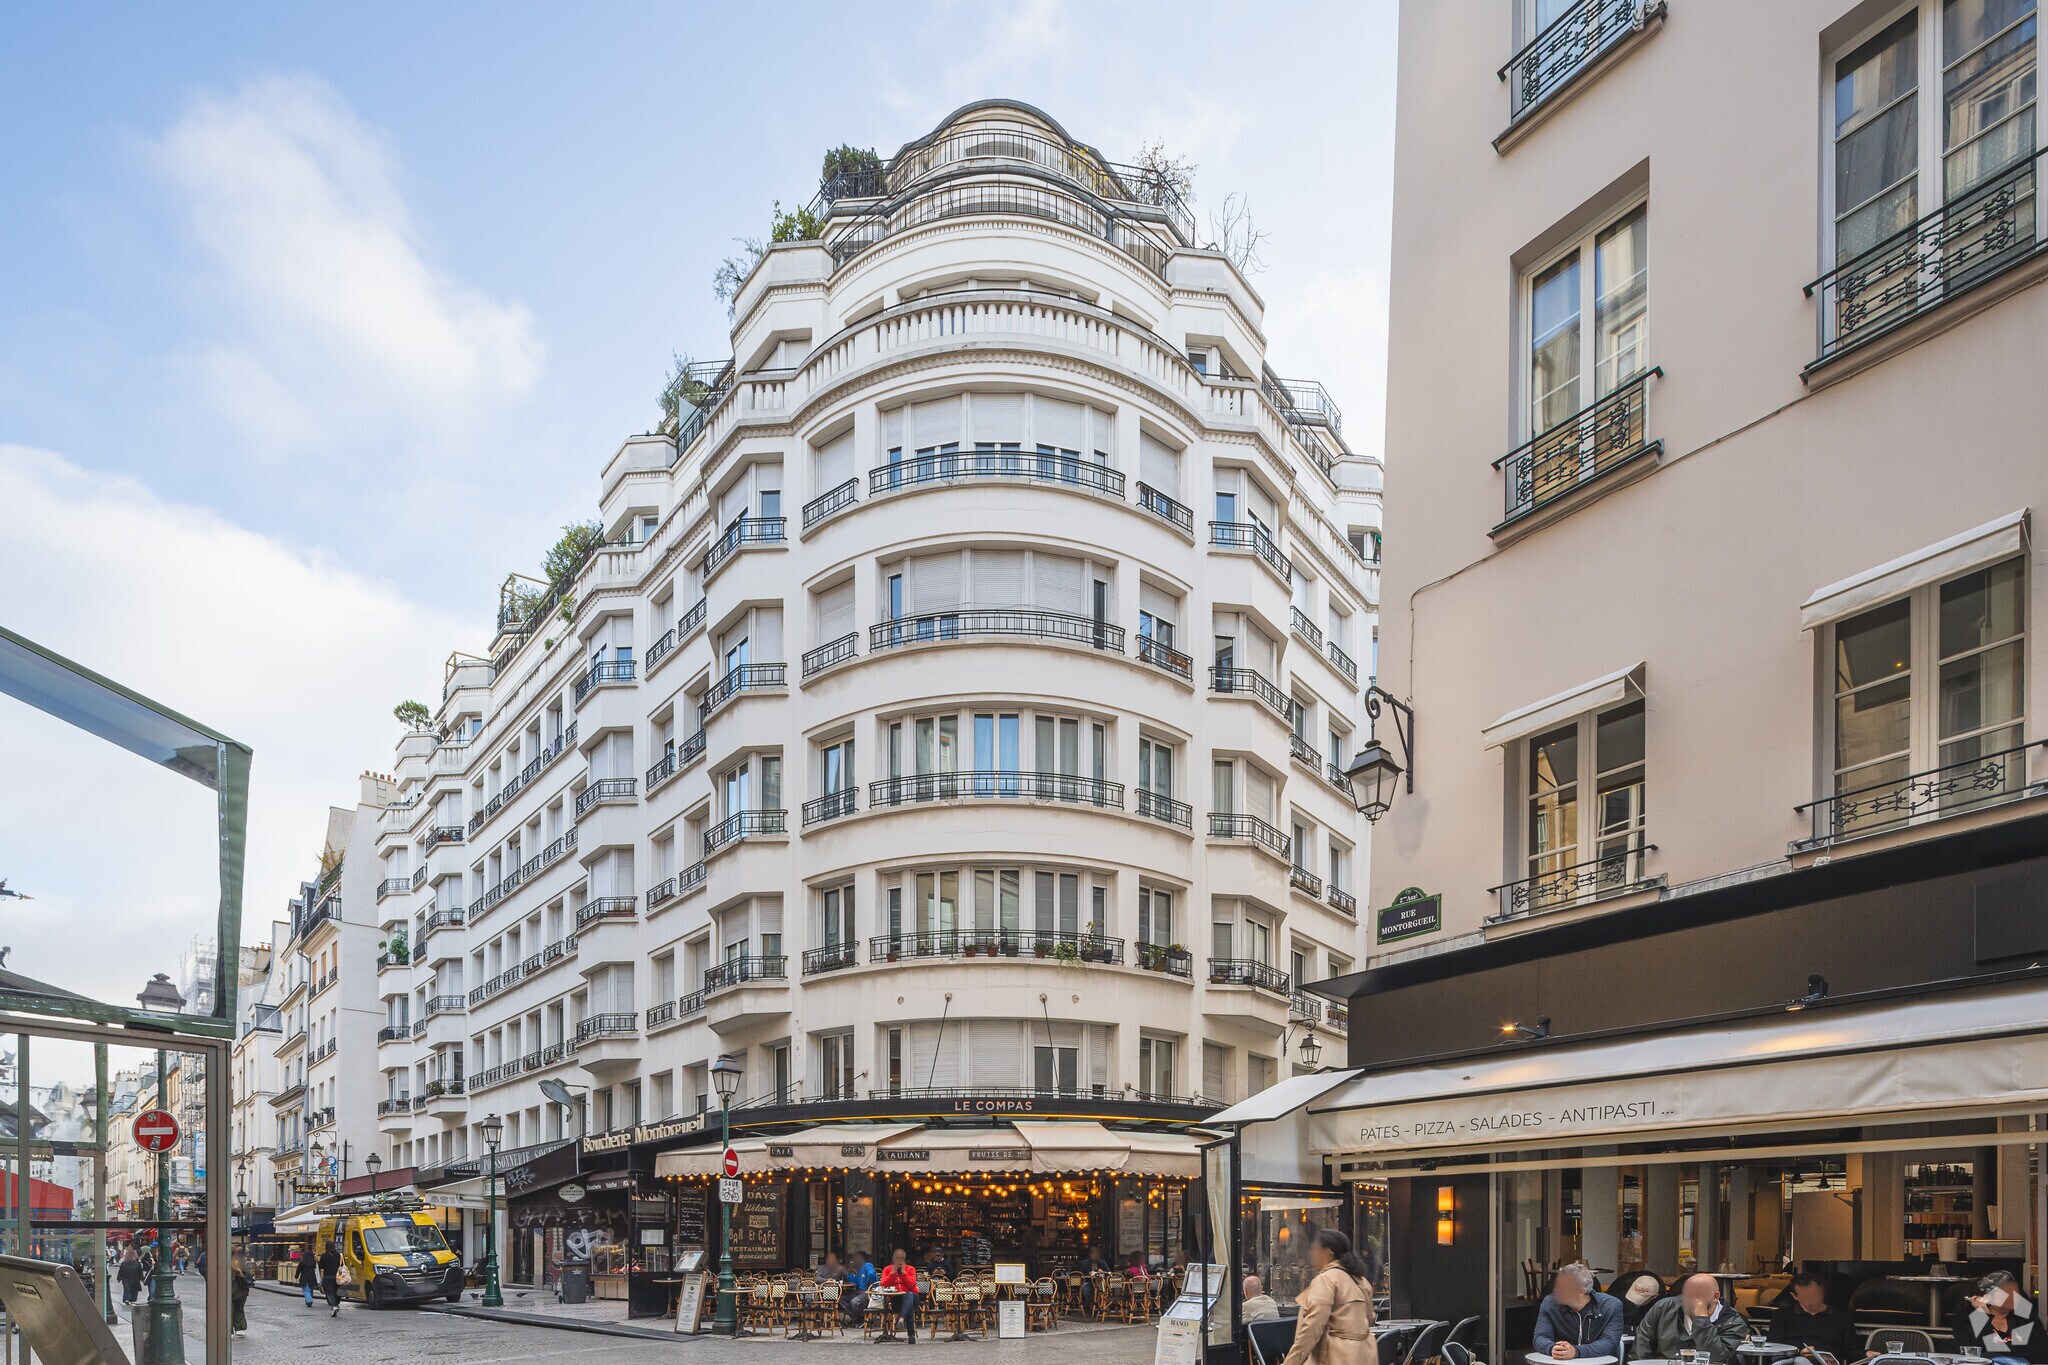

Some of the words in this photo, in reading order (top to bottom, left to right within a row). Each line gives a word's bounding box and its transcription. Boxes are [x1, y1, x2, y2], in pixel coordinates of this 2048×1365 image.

[1401, 909, 1416, 919] RUE
[1381, 915, 1436, 935] MONTORGUEIL
[955, 1101, 970, 1111] LE
[976, 1101, 1033, 1111] COMPAS
[1360, 1125, 1400, 1140] PATES
[1415, 1121, 1456, 1136] PIZZA
[1470, 1112, 1542, 1131] SALADES
[1560, 1101, 1655, 1123] ANTIPASTI
[583, 1130, 631, 1153] Boucherie
[635, 1113, 705, 1143] Montorgueil
[484, 1151, 530, 1170] POSSONNERIE
[747, 1192, 777, 1200] DAYS
[744, 1203, 775, 1213] Welcome
[728, 1228, 744, 1244] BAR
[1170, 1319, 1189, 1327] BIANCO
